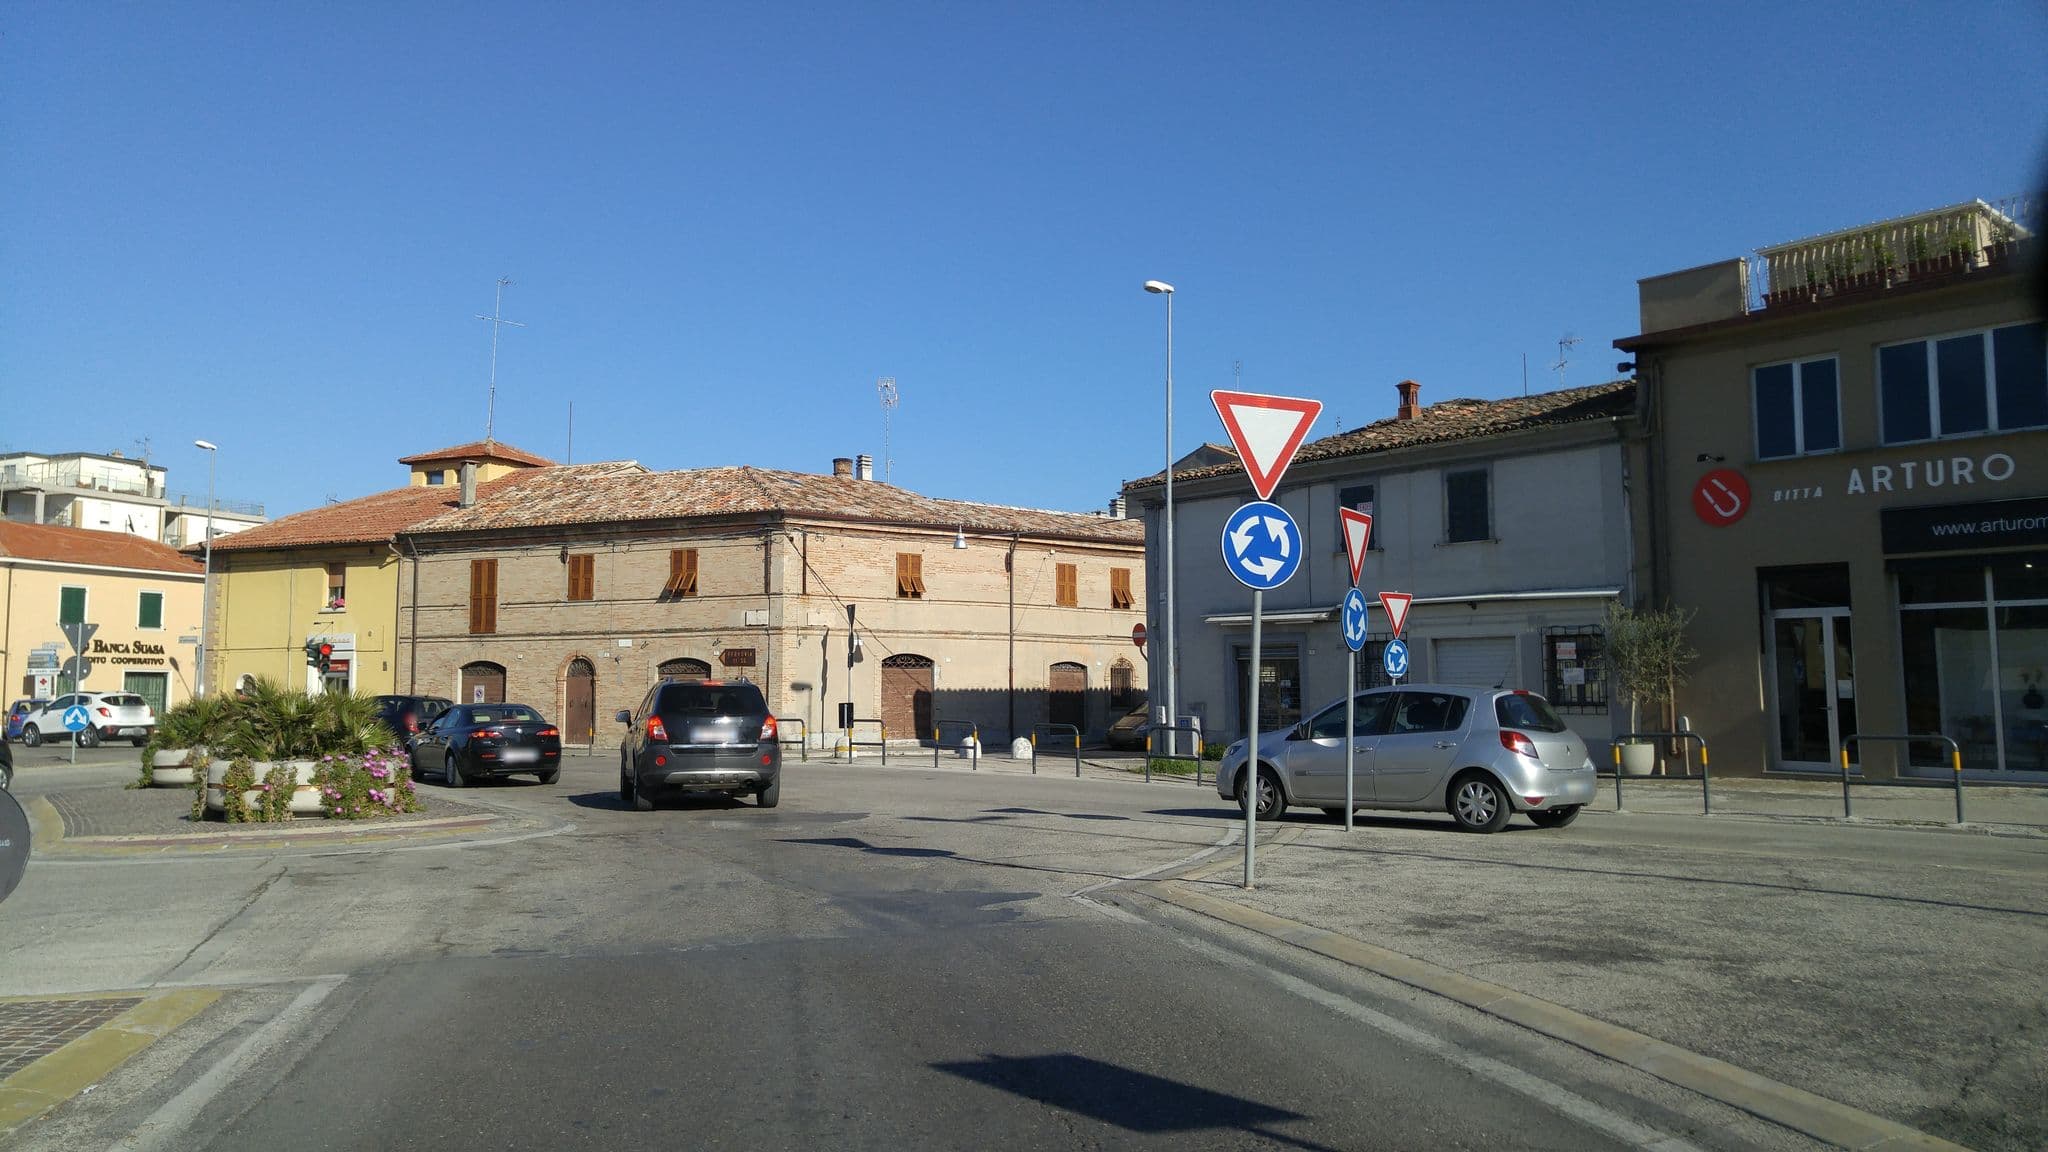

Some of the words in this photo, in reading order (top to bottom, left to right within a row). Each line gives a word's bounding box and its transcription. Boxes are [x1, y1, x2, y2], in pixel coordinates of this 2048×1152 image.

[1847, 453, 2017, 495] ARTURO
[93, 640, 130, 653] BANCA
[111, 657, 165, 665] COOPERATIVO
